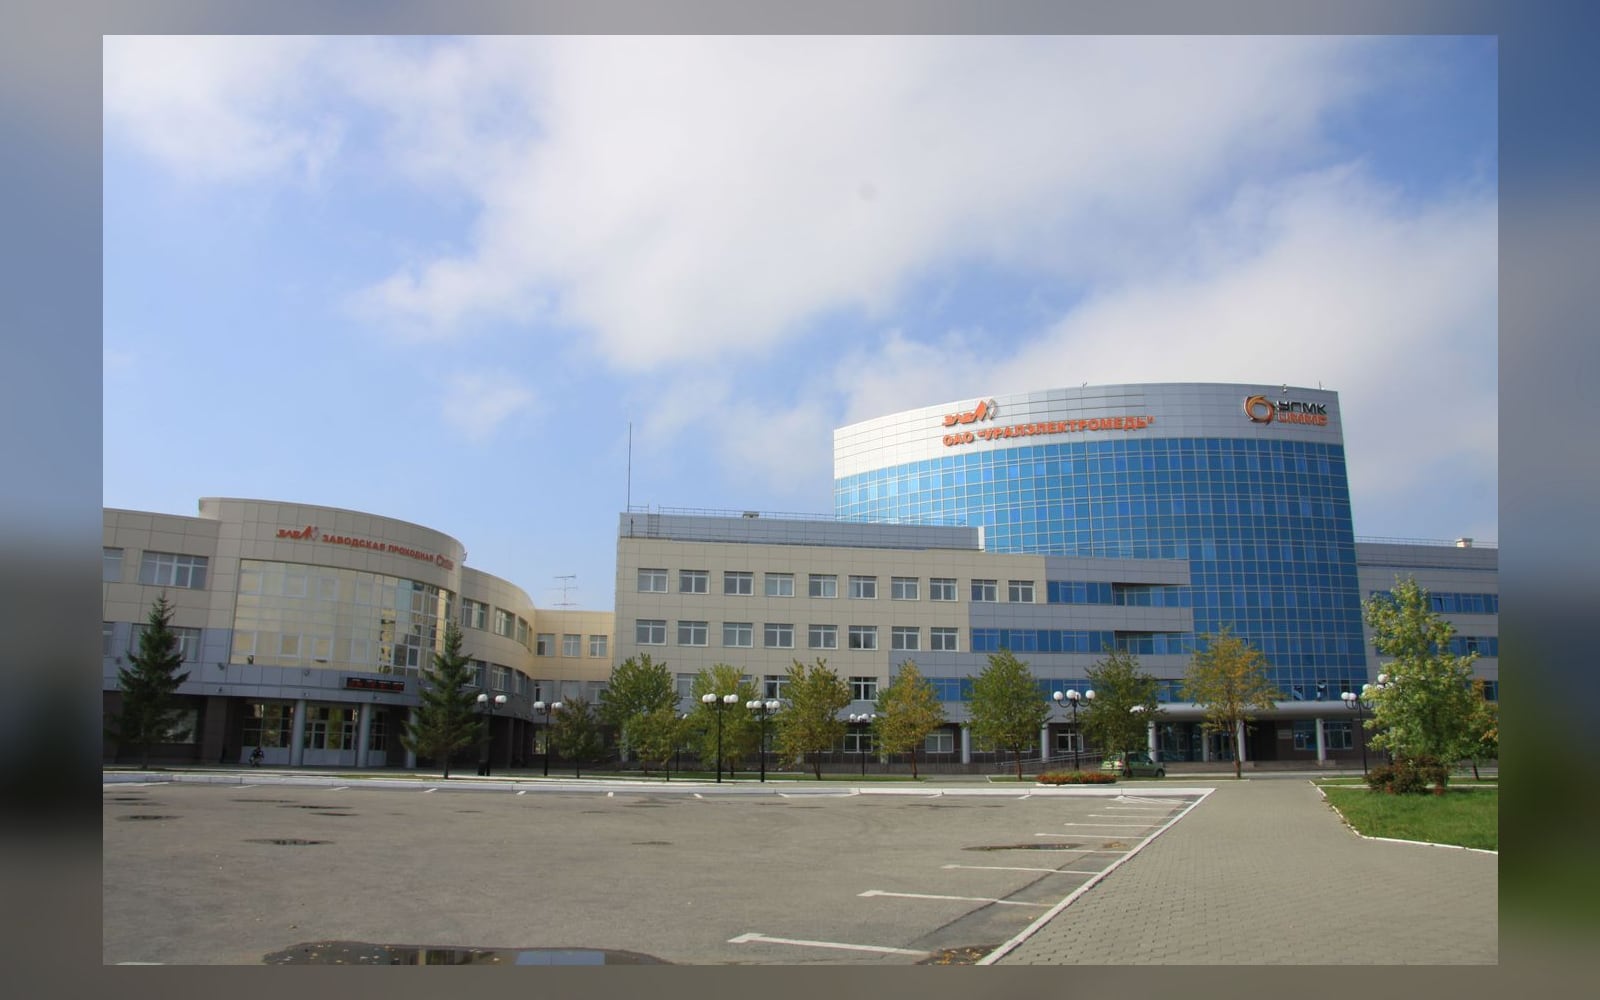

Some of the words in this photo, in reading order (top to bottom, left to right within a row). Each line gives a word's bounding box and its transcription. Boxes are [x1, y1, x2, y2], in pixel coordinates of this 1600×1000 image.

[943, 432, 974, 446] ОАО
[322, 534, 385, 550] ЗАВОДСКАЯ
[388, 544, 434, 563] ПРОХОДНАЯ
